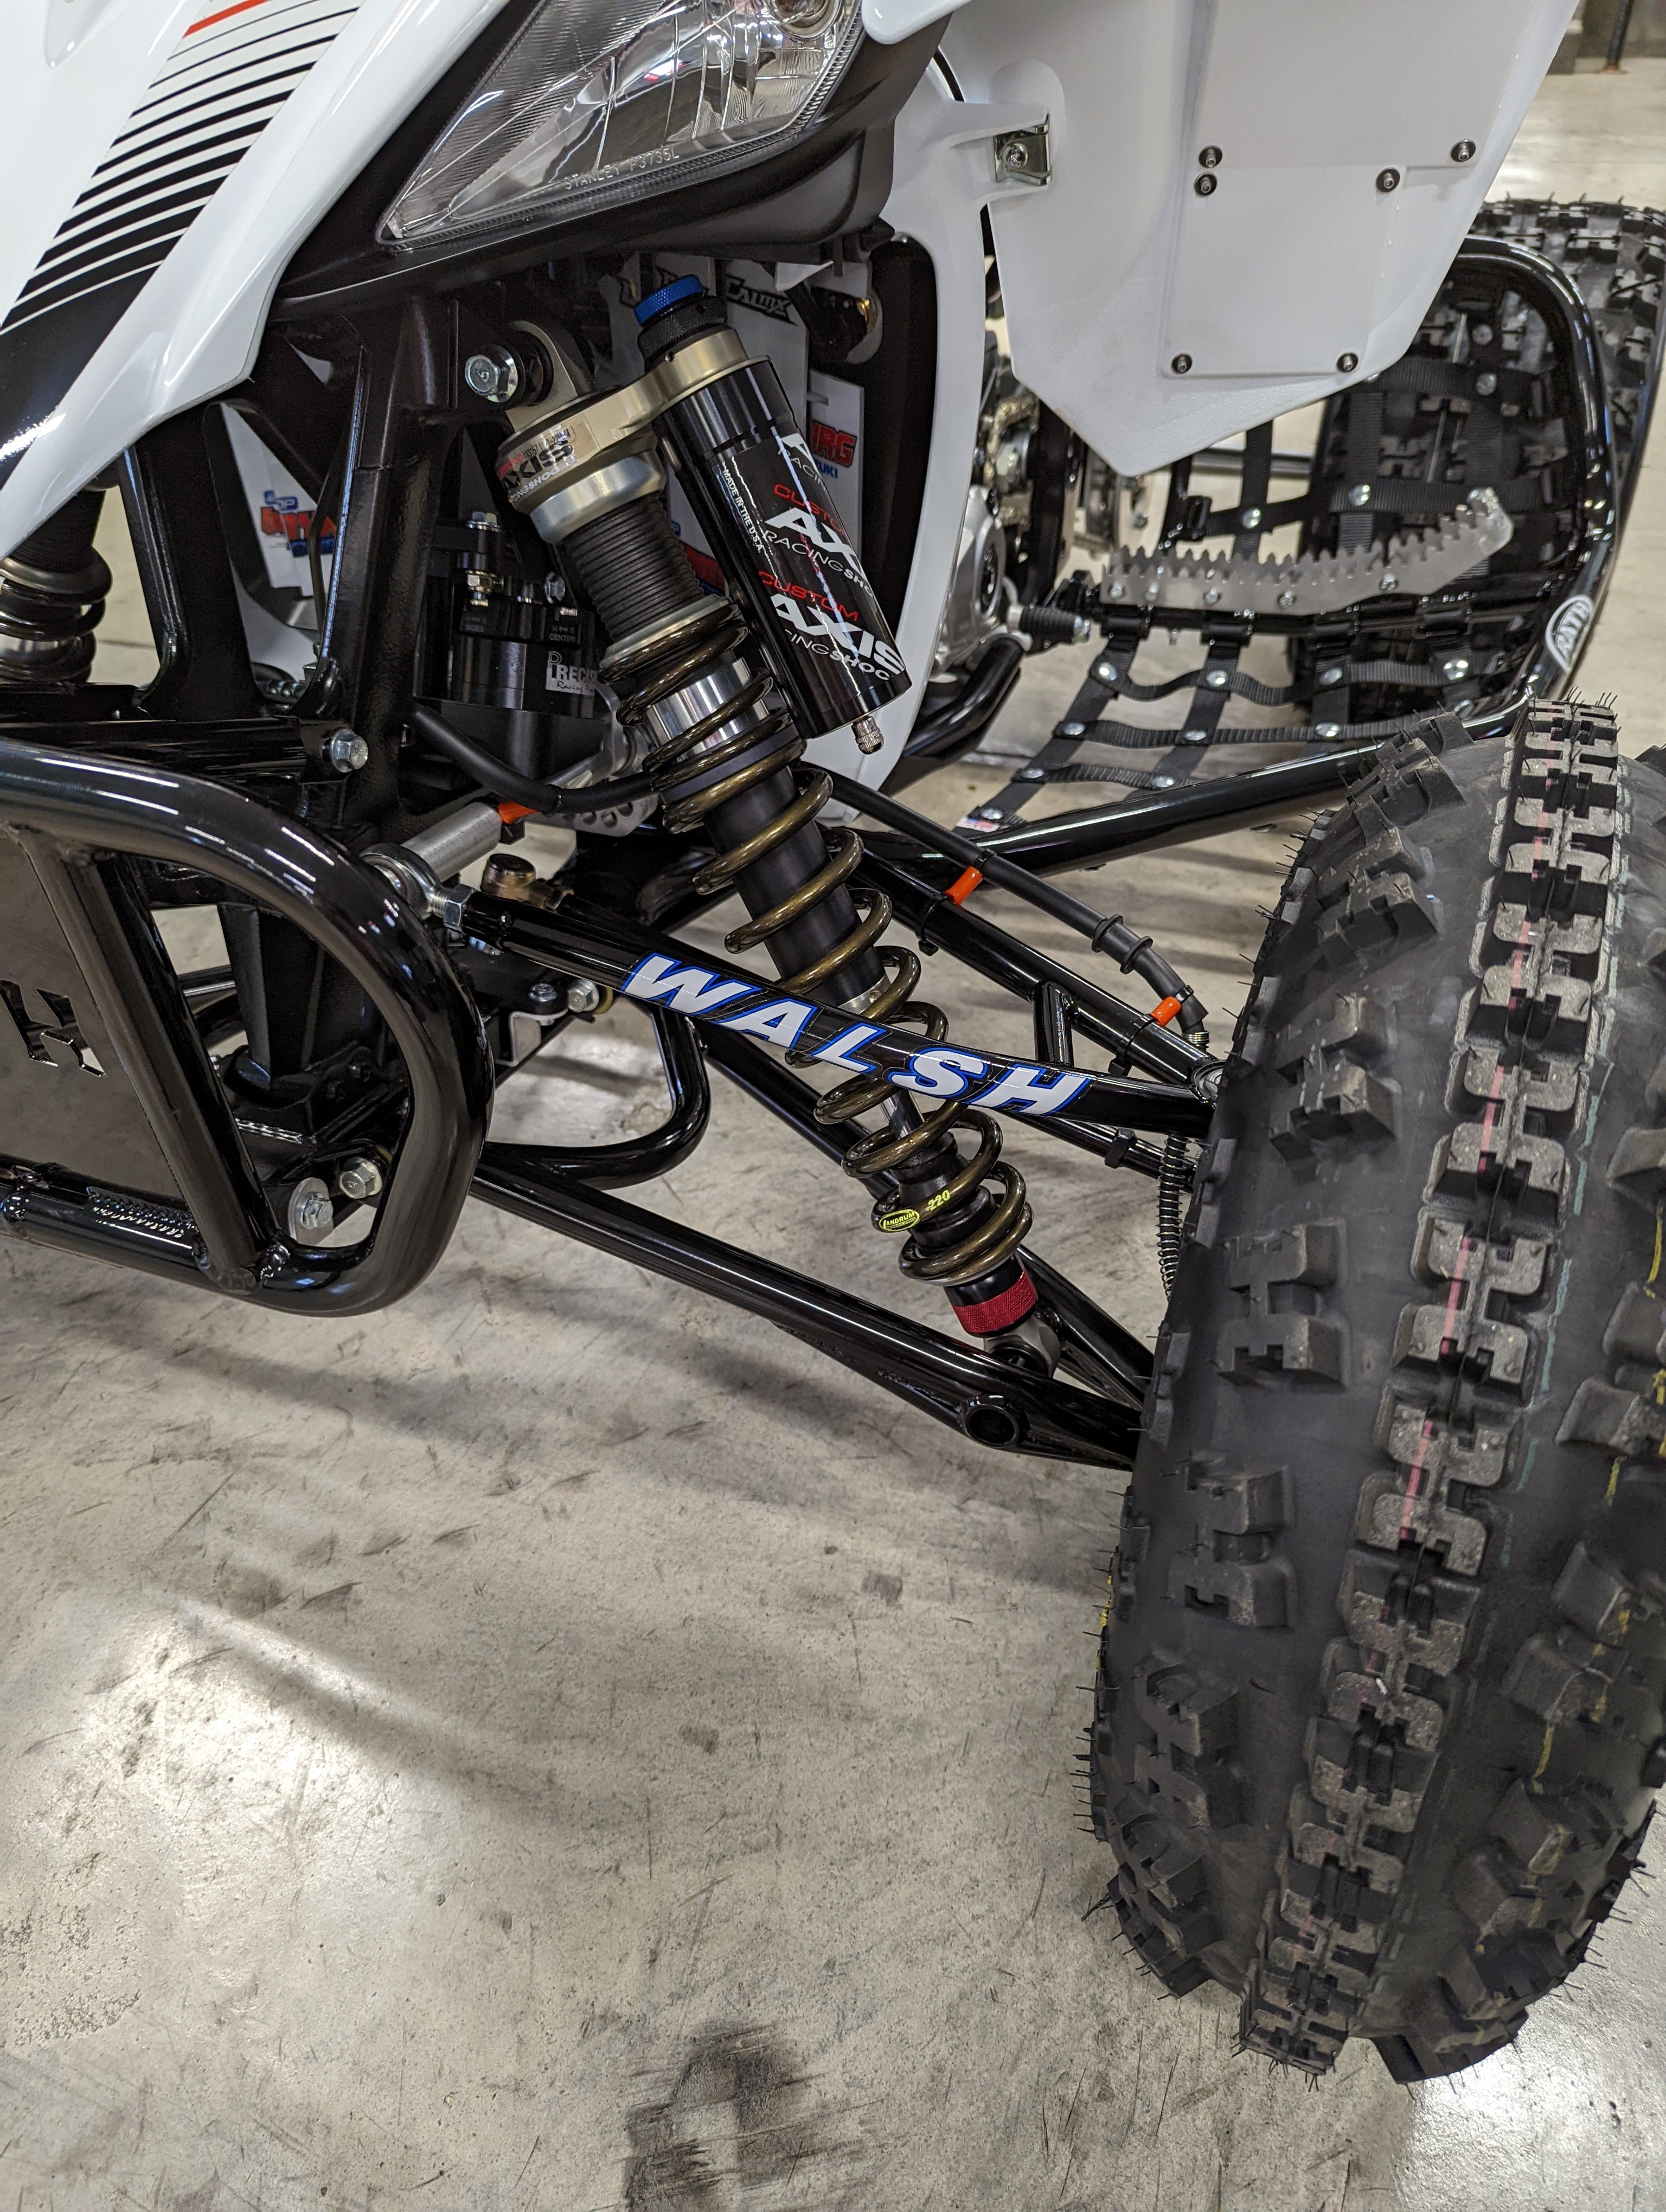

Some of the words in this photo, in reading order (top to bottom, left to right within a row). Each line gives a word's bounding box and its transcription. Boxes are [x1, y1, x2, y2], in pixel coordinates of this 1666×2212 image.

[563, 164, 619, 190] STANLEY
[630, 147, 680, 171] P3735L
[722, 468, 740, 497] MADE
[734, 496, 745, 509] IN
[740, 505, 755, 527] THE
[765, 507, 864, 580] AX
[759, 570, 859, 622] CUSTOM
[549, 634, 576, 643] CENTER
[770, 593, 907, 675] AXIS
[1556, 599, 1591, 658] RATH
[547, 651, 597, 683] PRECIS
[785, 629, 890, 681] INGSHOC
[556, 680, 584, 693] Racing
[620, 952, 1092, 1118] WALSH
[883, 1211, 915, 1230] LANDRUM
[928, 1189, 951, 1211] 220
